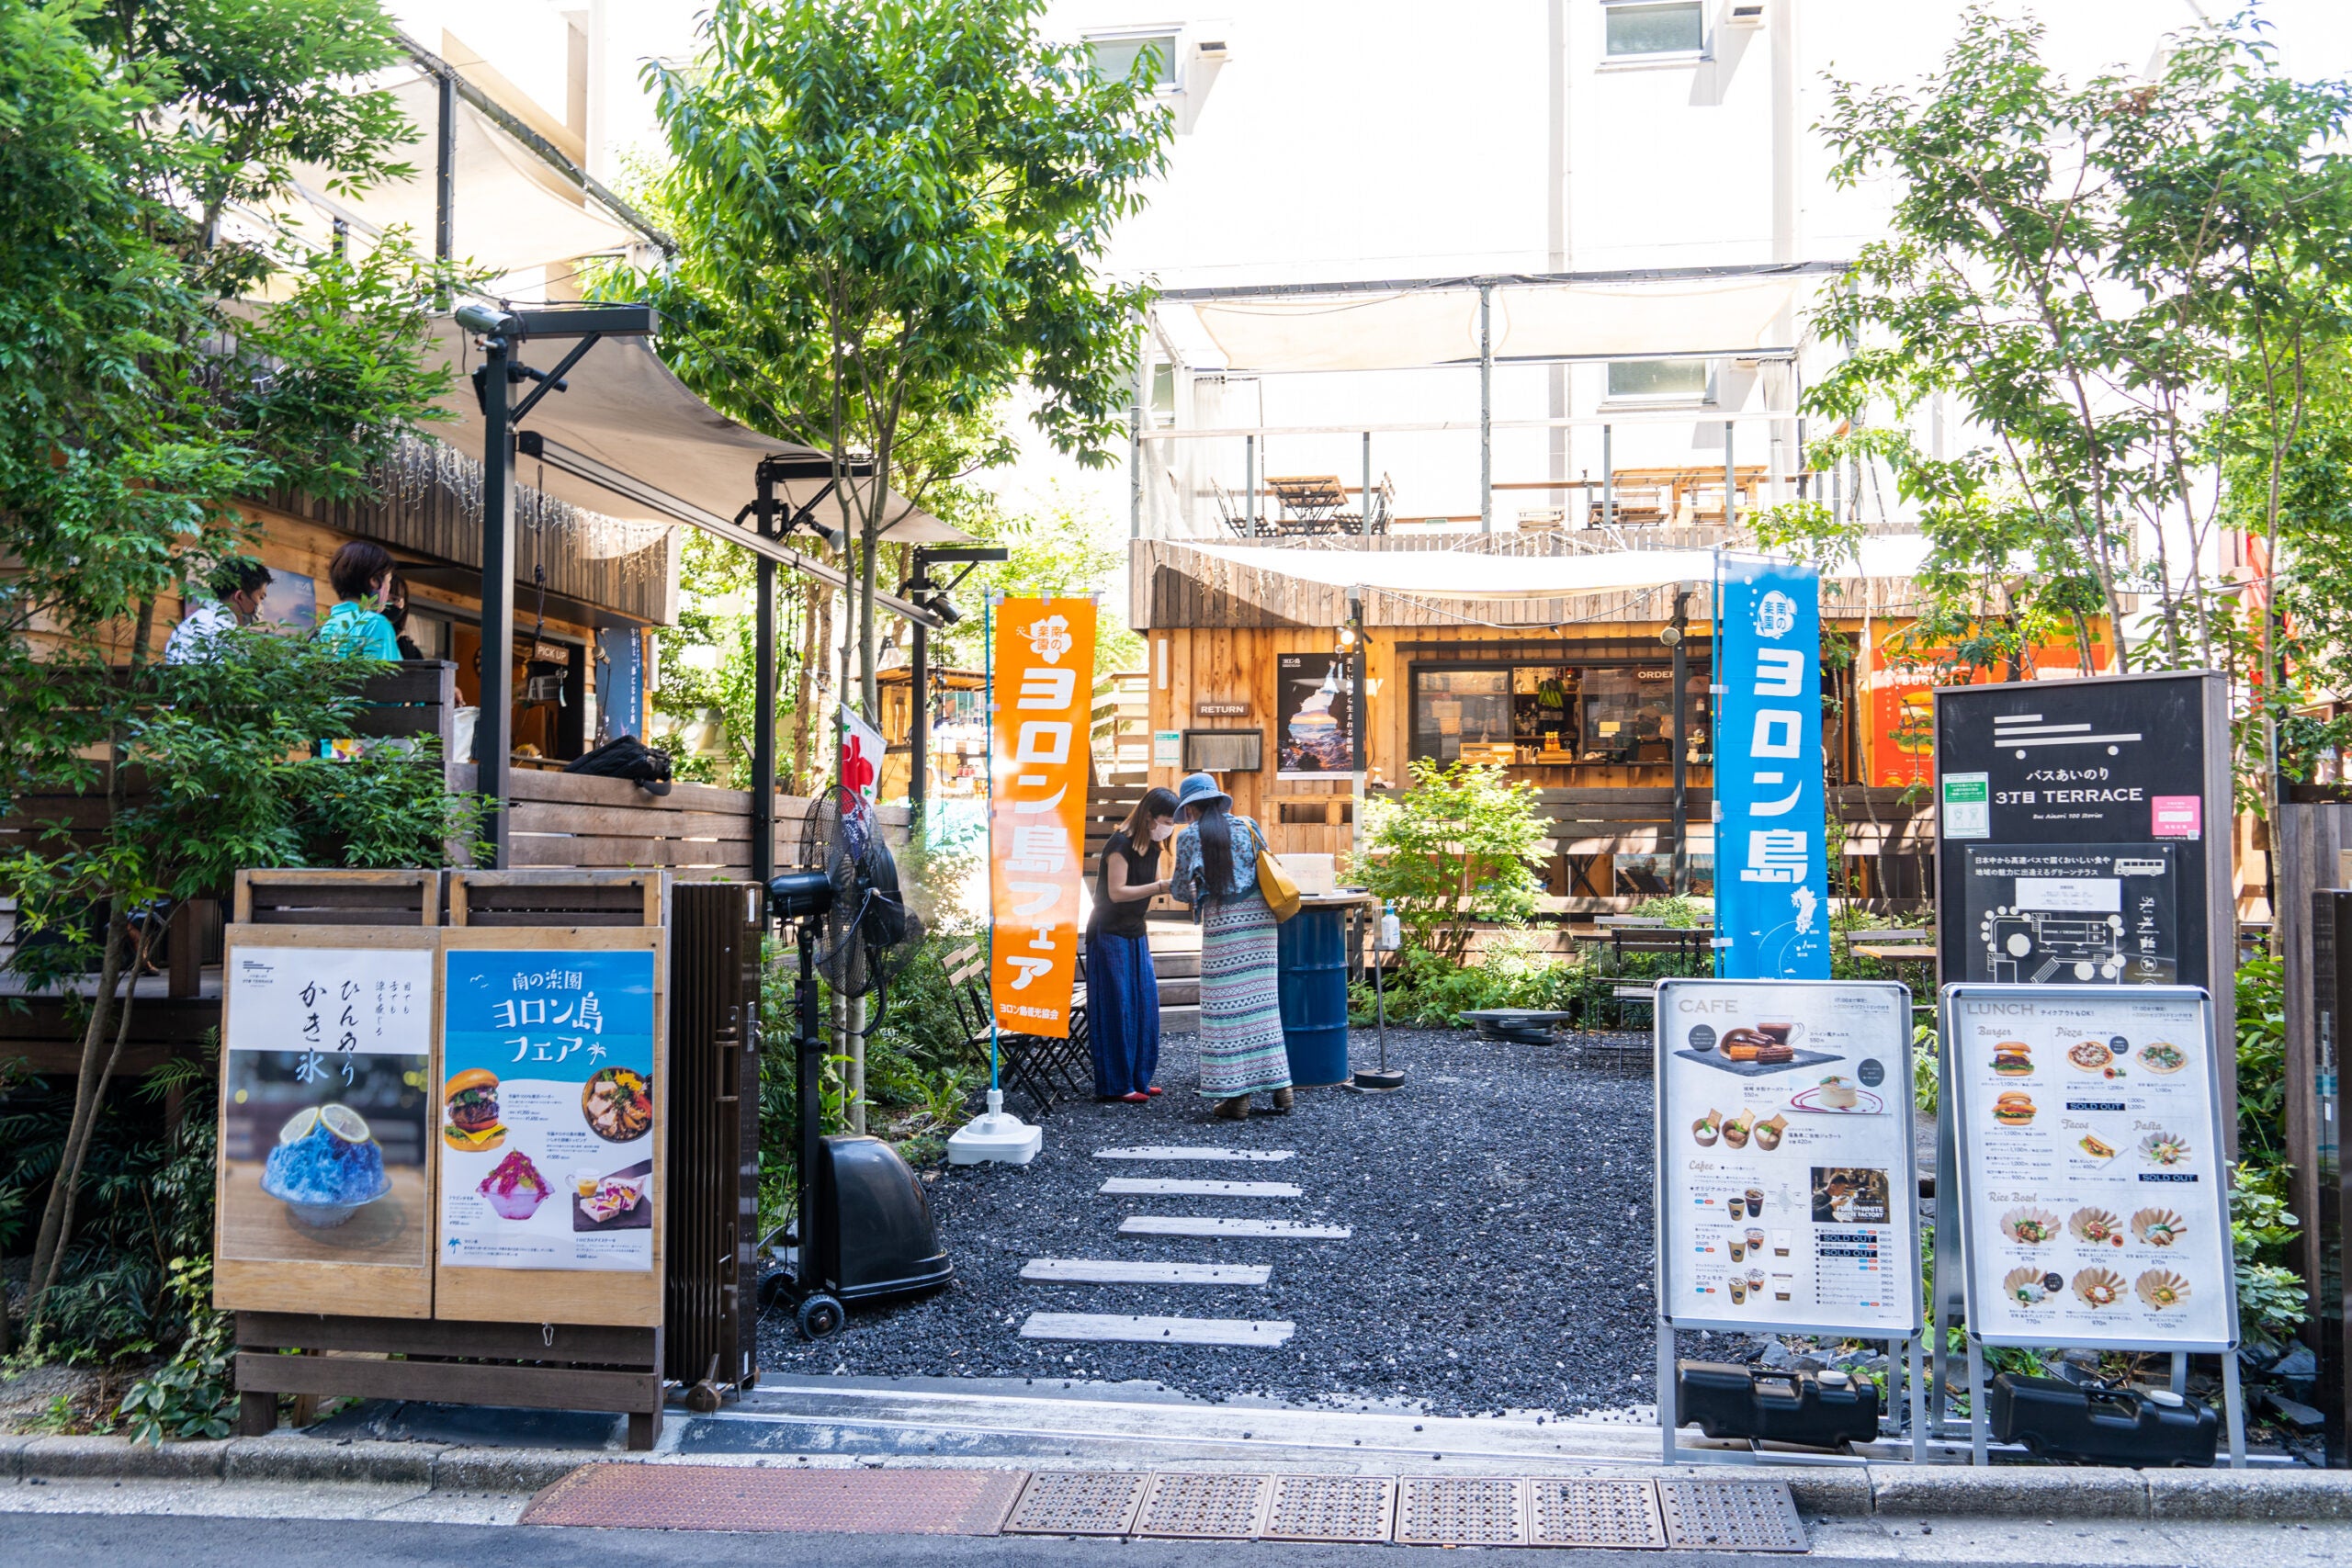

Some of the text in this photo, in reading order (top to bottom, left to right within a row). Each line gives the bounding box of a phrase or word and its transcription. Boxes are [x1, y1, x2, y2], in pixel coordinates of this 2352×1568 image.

[537, 645, 567, 660] PICK UP
[1201, 705, 1244, 714] RETURN
[1740, 648, 1808, 883] ヨロン島
[2026, 767, 2109, 782] バスあいのり
[1995, 787, 2143, 804] 3丁目 TERRACE
[1005, 668, 1076, 990] ヨロン島フェア
[512, 969, 582, 991] 南の楽園
[492, 990, 603, 1034] ヨロン島
[1679, 999, 1738, 1013] CAFE
[1967, 1003, 2035, 1015] LUNCH
[295, 980, 329, 1085] かき氷
[337, 980, 360, 1087] ひんやり
[1977, 1026, 2012, 1038] Burger
[2055, 1026, 2083, 1037] Pizza
[504, 1036, 582, 1063] フェア
[2061, 1119, 2089, 1130] Tacos
[2132, 1121, 2162, 1131] Pasta
[1988, 1191, 2038, 1202] Rice Bowl
